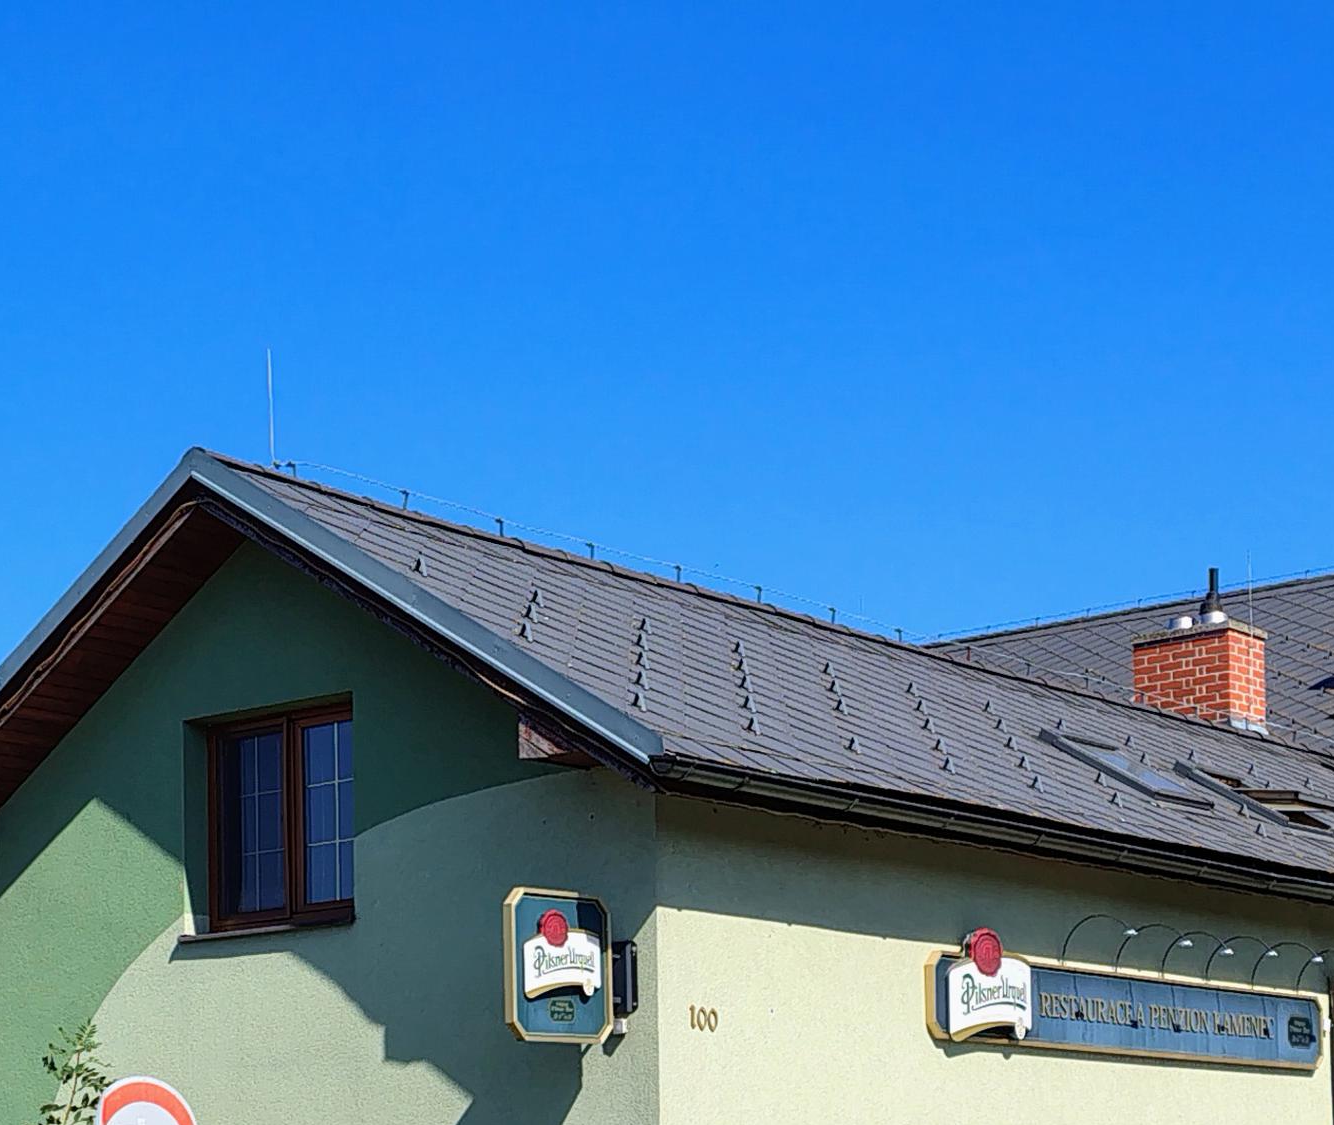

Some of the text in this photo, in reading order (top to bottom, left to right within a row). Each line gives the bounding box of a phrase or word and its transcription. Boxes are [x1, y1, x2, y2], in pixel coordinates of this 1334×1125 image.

[533, 945, 595, 978] Pilsner Urquell
[961, 973, 1028, 1015] Pilsner Urquell
[689, 1004, 718, 1032] 100
[1039, 991, 1133, 1026] RESTAURACE
[1137, 1001, 1146, 1028] A
[1148, 1004, 1209, 1034] PENZION
[1212, 1011, 1275, 1040] KAMENEC
